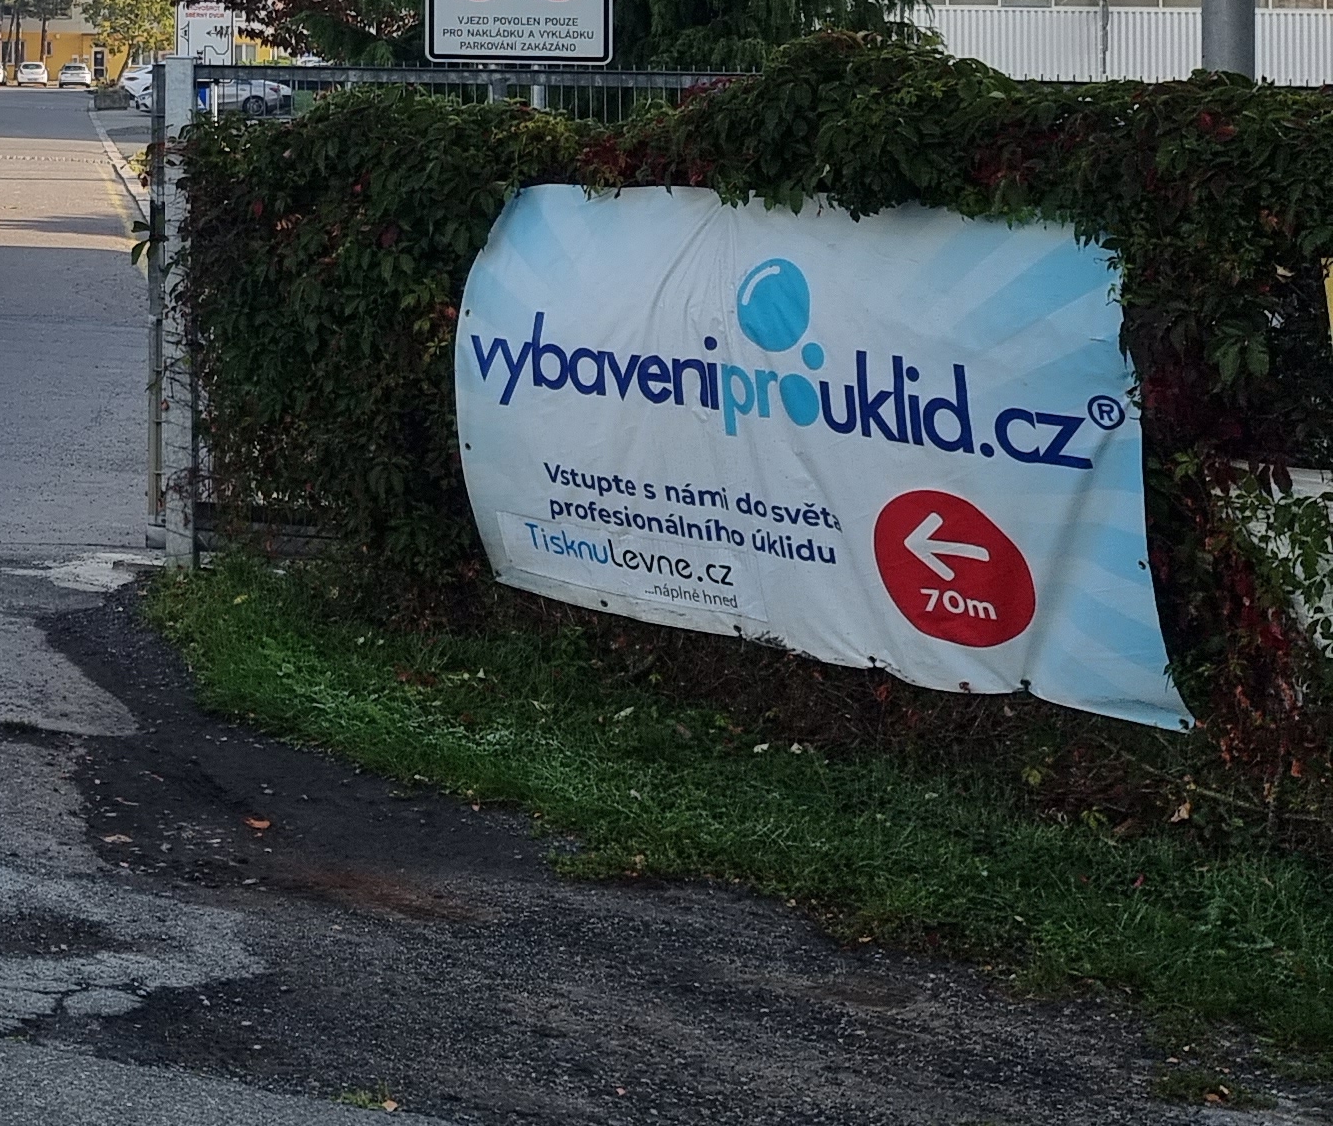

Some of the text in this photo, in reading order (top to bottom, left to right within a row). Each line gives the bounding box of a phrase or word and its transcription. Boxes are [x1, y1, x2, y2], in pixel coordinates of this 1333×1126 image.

[457, 16, 579, 27] VJEZD POVOLEN POUZE
[442, 27, 594, 40] PRO NAKLÁDKU A VYKLÁDKU
[459, 40, 577, 52] PARKOVÁNÍ ZAKÁZÁNO
[544, 462, 637, 497] Vstupte
[644, 483, 657, 500] s
[665, 483, 729, 511] námi
[550, 498, 837, 565] profesionálního úklidu
